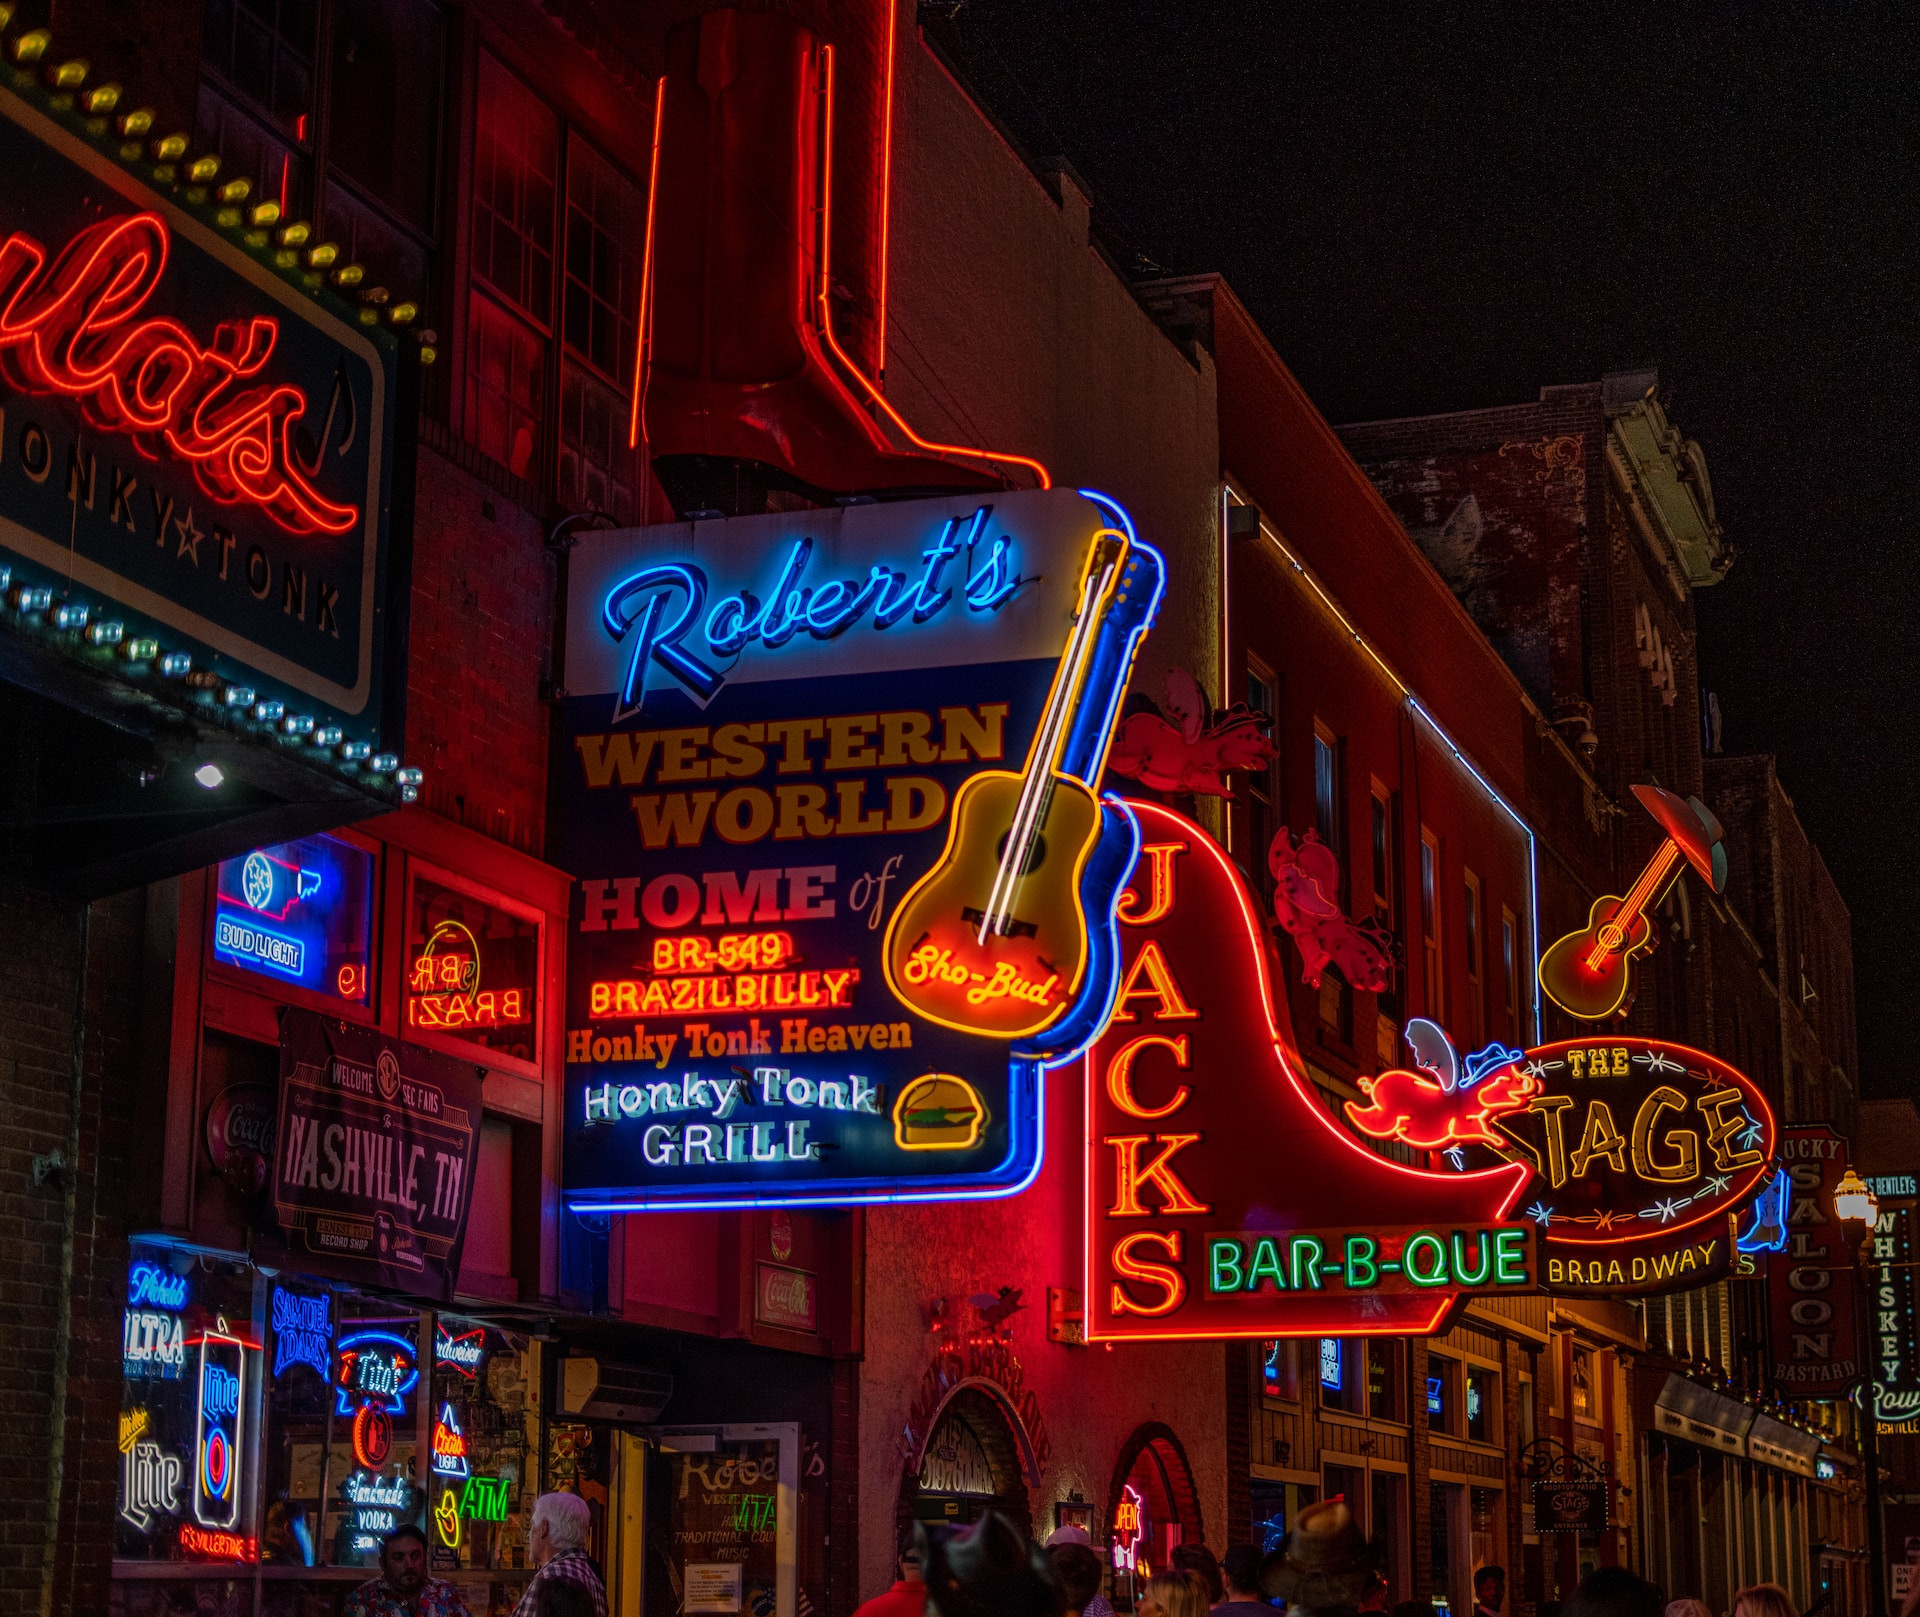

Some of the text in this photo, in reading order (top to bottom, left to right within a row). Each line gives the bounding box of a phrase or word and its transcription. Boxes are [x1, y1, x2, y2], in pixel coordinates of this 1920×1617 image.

[0, 407, 340, 639] ONKY TONK
[603, 505, 1022, 715] Robert's
[576, 704, 1007, 789] WESTERN
[632, 776, 955, 849] WORLD
[579, 856, 902, 933] HOME of
[219, 921, 299, 968] BUD LIGHT
[650, 932, 790, 975] BR-549
[589, 970, 858, 1018] BRAZILBILLY
[904, 945, 1058, 1007] Sho-Bud
[567, 1018, 912, 1069] Honky Tonk Heaven
[1568, 1047, 1630, 1079] THE
[332, 1063, 374, 1094] WELCOME
[402, 1084, 439, 1113] SEC FANS
[585, 1066, 882, 1122] Honky Tonk
[1106, 841, 1209, 1319] JACKS
[642, 1118, 815, 1167] GRILL
[1784, 1138, 1842, 1160] UCKY
[284, 1113, 464, 1222] NASHVILLE, TN
[319, 1220, 349, 1236] ERNEST
[320, 1234, 369, 1250] RECORD SHOP
[1208, 1226, 1529, 1295] BAR-B-QUE
[1549, 1240, 1717, 1284] BROADWAY
[1787, 1162, 1834, 1359] SALOON
[273, 1288, 333, 1337] SAMUEL
[1873, 1211, 1900, 1382] WHISKEY
[274, 1330, 328, 1377] ADAMS
[359, 1350, 402, 1395] Tito's
[437, 1336, 482, 1362] udweiser
[1775, 1358, 1856, 1383] BASTARD
[203, 1363, 239, 1421] Lite
[1876, 1418, 1920, 1435] ASHVILLE
[120, 1443, 180, 1529] Lite
[459, 1476, 510, 1521] ATM
[1577, 1483, 1597, 1491] PATIO
[358, 1511, 393, 1529] VODKA
[674, 1530, 743, 1545] TRADITIONAL
[717, 1547, 749, 1559] MUSIC
